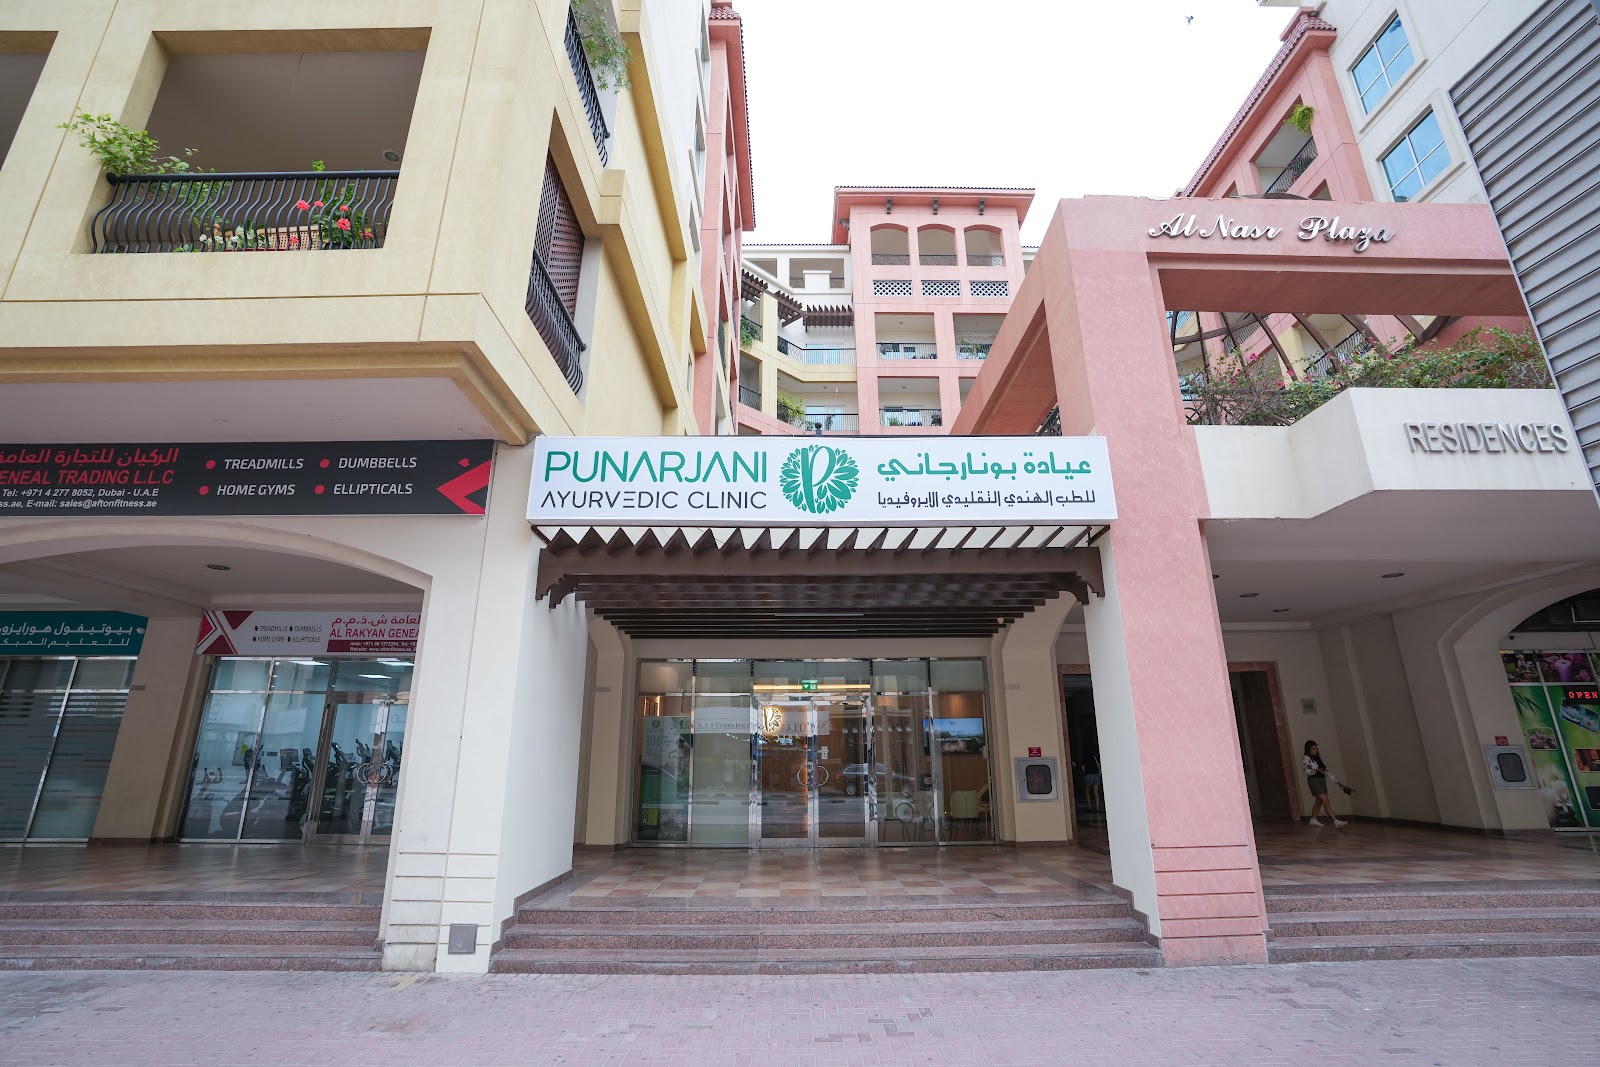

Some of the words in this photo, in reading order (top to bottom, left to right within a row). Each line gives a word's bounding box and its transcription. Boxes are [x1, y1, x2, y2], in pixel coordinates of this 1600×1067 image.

[1148, 212, 1199, 238] Al
[1199, 214, 1282, 239] Nasr
[1298, 216, 1395, 252] Plaza
[1403, 422, 1569, 453] RESIDENCES
[54, 448, 115, 467] للتجارة
[117, 447, 180, 467] الركيان
[224, 458, 305, 470] TREADMILLS
[338, 457, 417, 469] DUMBBELLS
[877, 451, 1017, 481] بونارجاني
[1023, 451, 1092, 480] عيادة
[544, 450, 767, 483] PUNARJANI
[57, 470, 130, 485] TRADING
[133, 470, 175, 485] L.L.C
[2, 488, 18, 498] Tel:
[21, 488, 43, 498] +971
[45, 488, 52, 498] 4
[53, 488, 71, 498] 277
[71, 488, 96, 499] 8052,
[98, 488, 126, 497] Dubai
[133, 488, 160, 497] U.A.E
[216, 484, 256, 496] HOME
[258, 484, 296, 496] GYMS
[332, 483, 413, 495] ELLIPTICALS
[26, 499, 58, 509] E-mail:
[59, 498, 157, 510] sales@aftonfitness.ae
[541, 490, 679, 509] AYURVEDIC
[687, 491, 767, 509] CLINIC
[942, 490, 1001, 508] التقليدي
[1003, 490, 1053, 508] الهندي
[1055, 490, 1096, 508] للطب
[0, 622, 52, 636] هورايزو
[53, 622, 133, 636] بيوتيفول
[329, 628, 343, 638] AL
[345, 628, 386, 638] RAKYAN
[48, 637, 130, 649] للتعليم
[1568, 690, 1599, 699] OPEN
